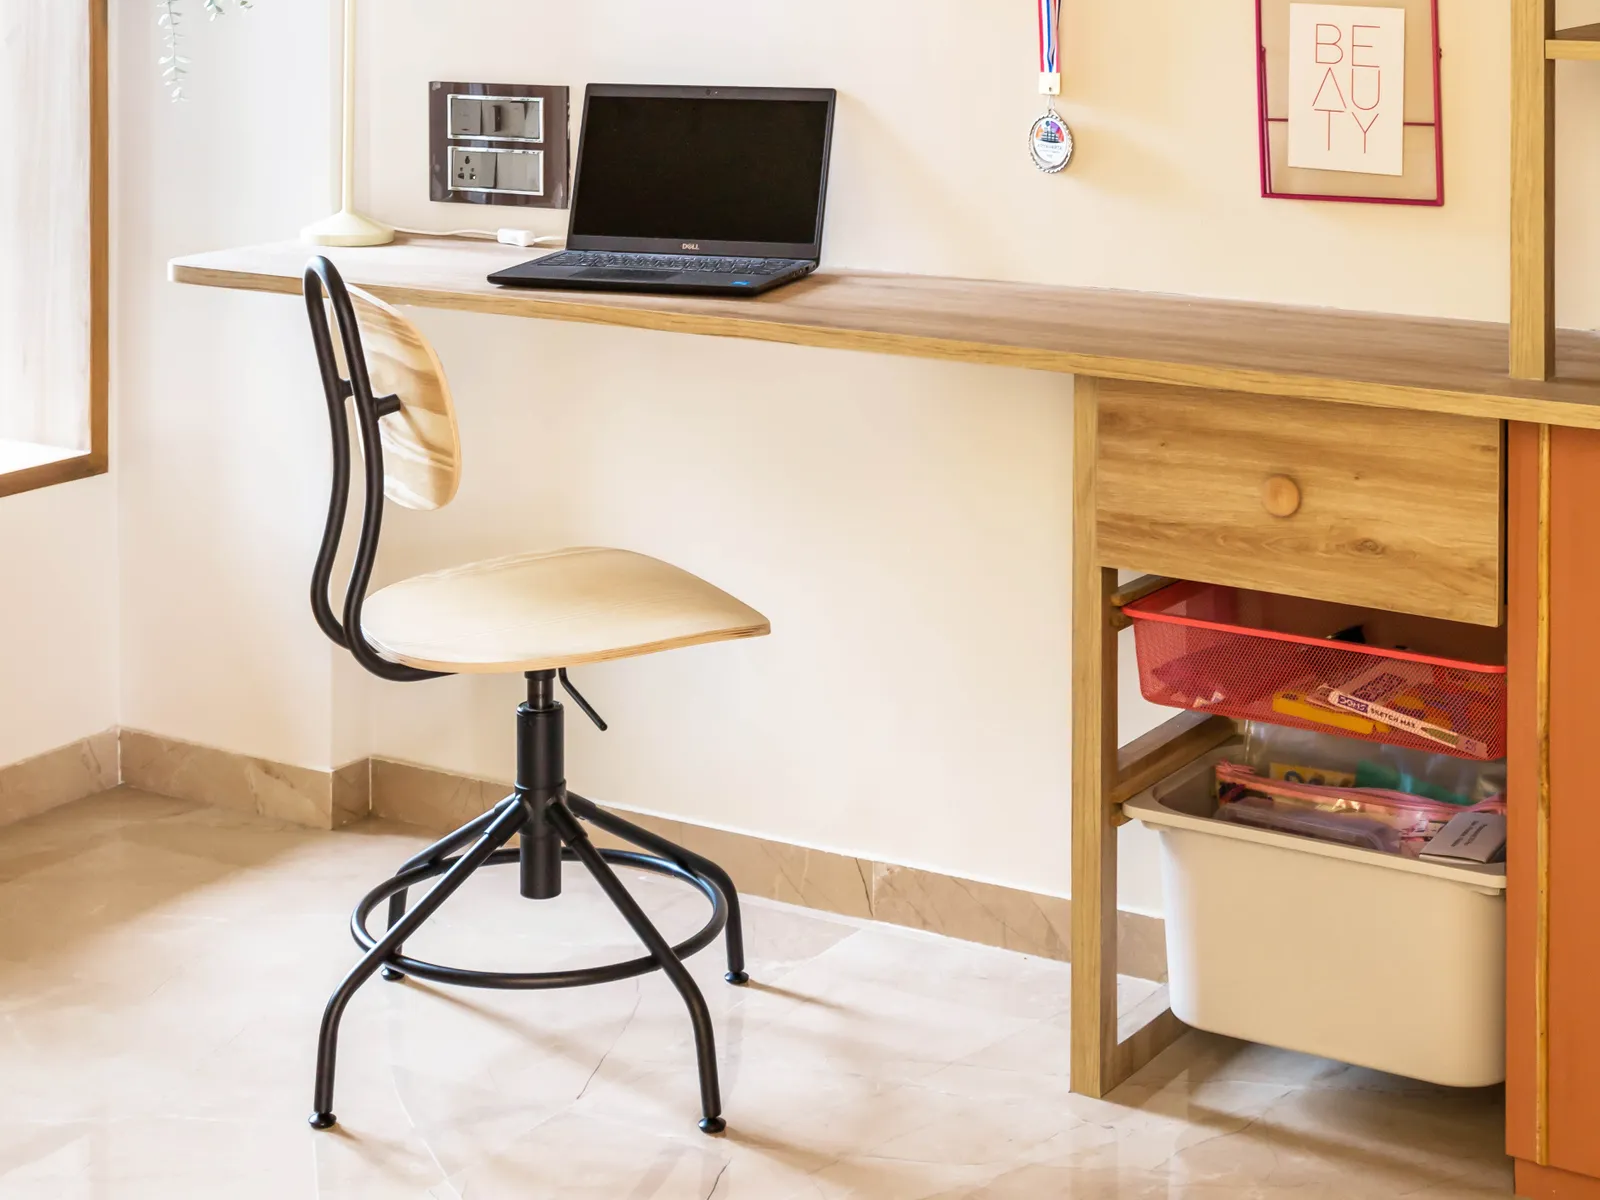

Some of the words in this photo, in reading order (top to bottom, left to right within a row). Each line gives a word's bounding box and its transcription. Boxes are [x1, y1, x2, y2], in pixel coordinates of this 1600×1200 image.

[1315, 23, 1380, 68] BE
[1314, 108, 1379, 154] TY
[1371, 708, 1399, 723] SKETCH
